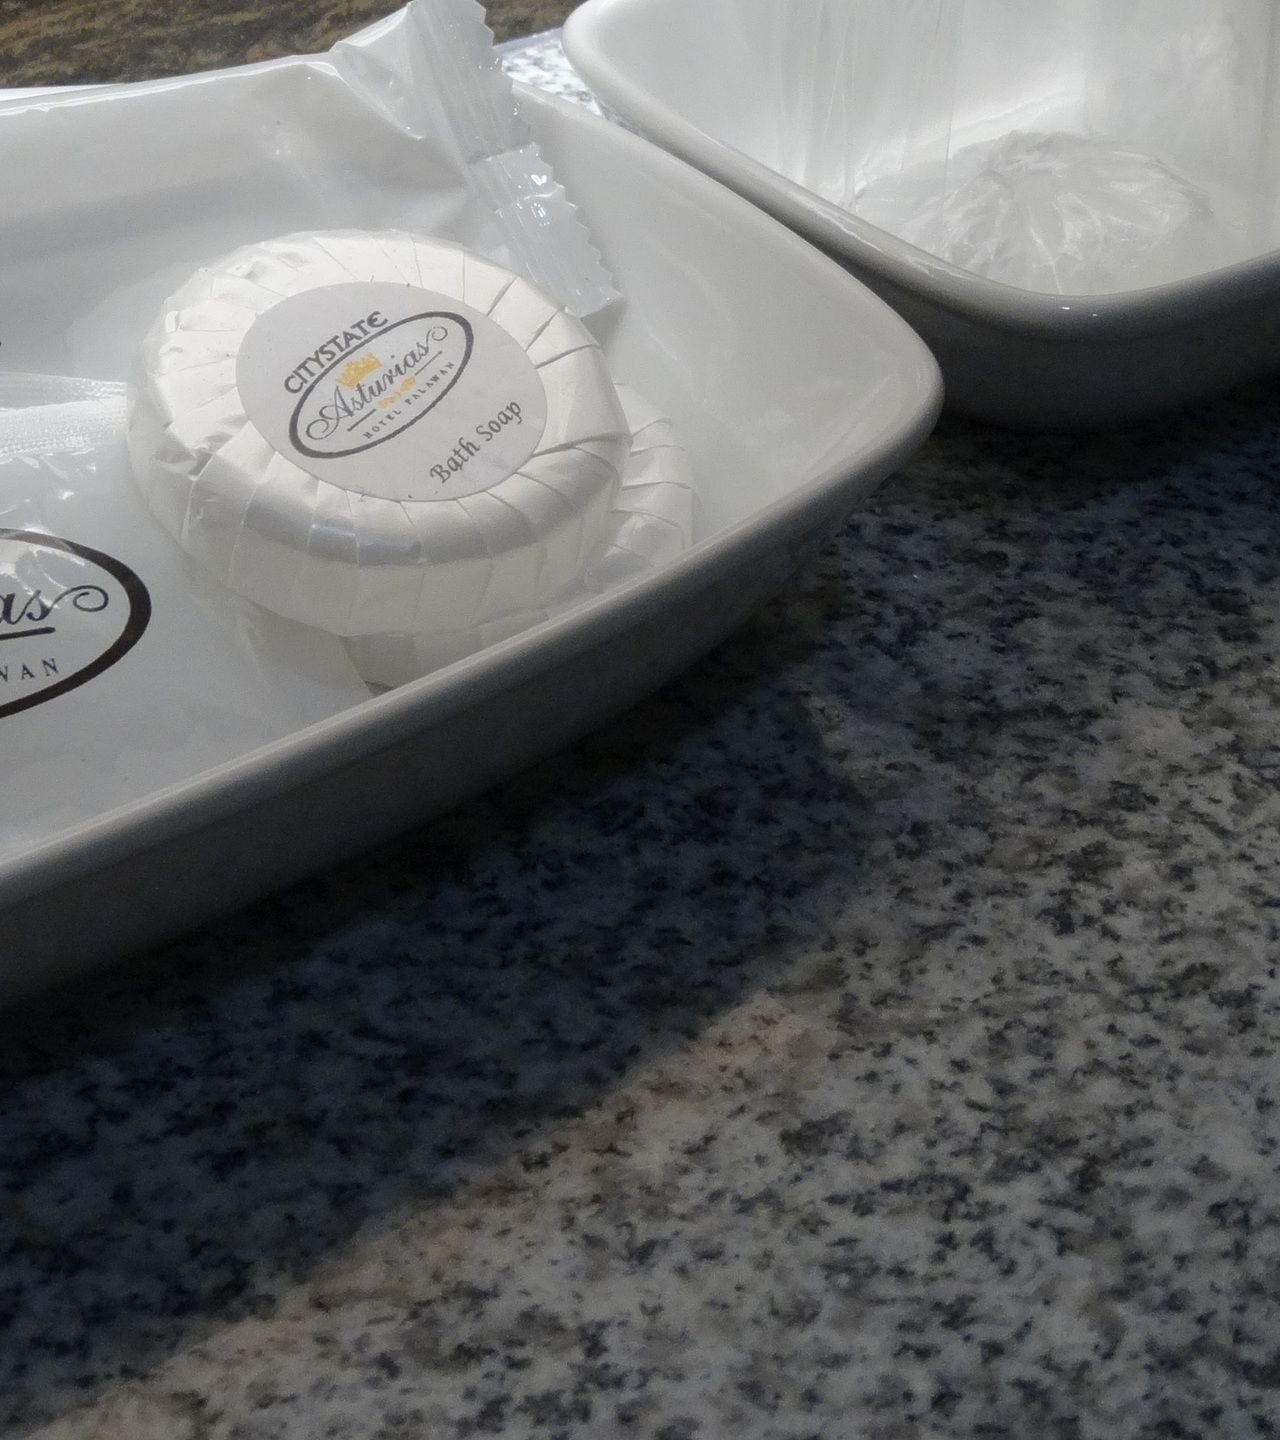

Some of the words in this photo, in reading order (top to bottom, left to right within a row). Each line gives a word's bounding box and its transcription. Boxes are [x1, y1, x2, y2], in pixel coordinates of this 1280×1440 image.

[283, 310, 388, 394] CITYSTATE
[305, 325, 448, 440] Asturias
[362, 409, 402, 440] HOTEL
[404, 361, 455, 406] PALAWAN
[429, 436, 481, 484] Bath
[475, 399, 523, 442] Soap
